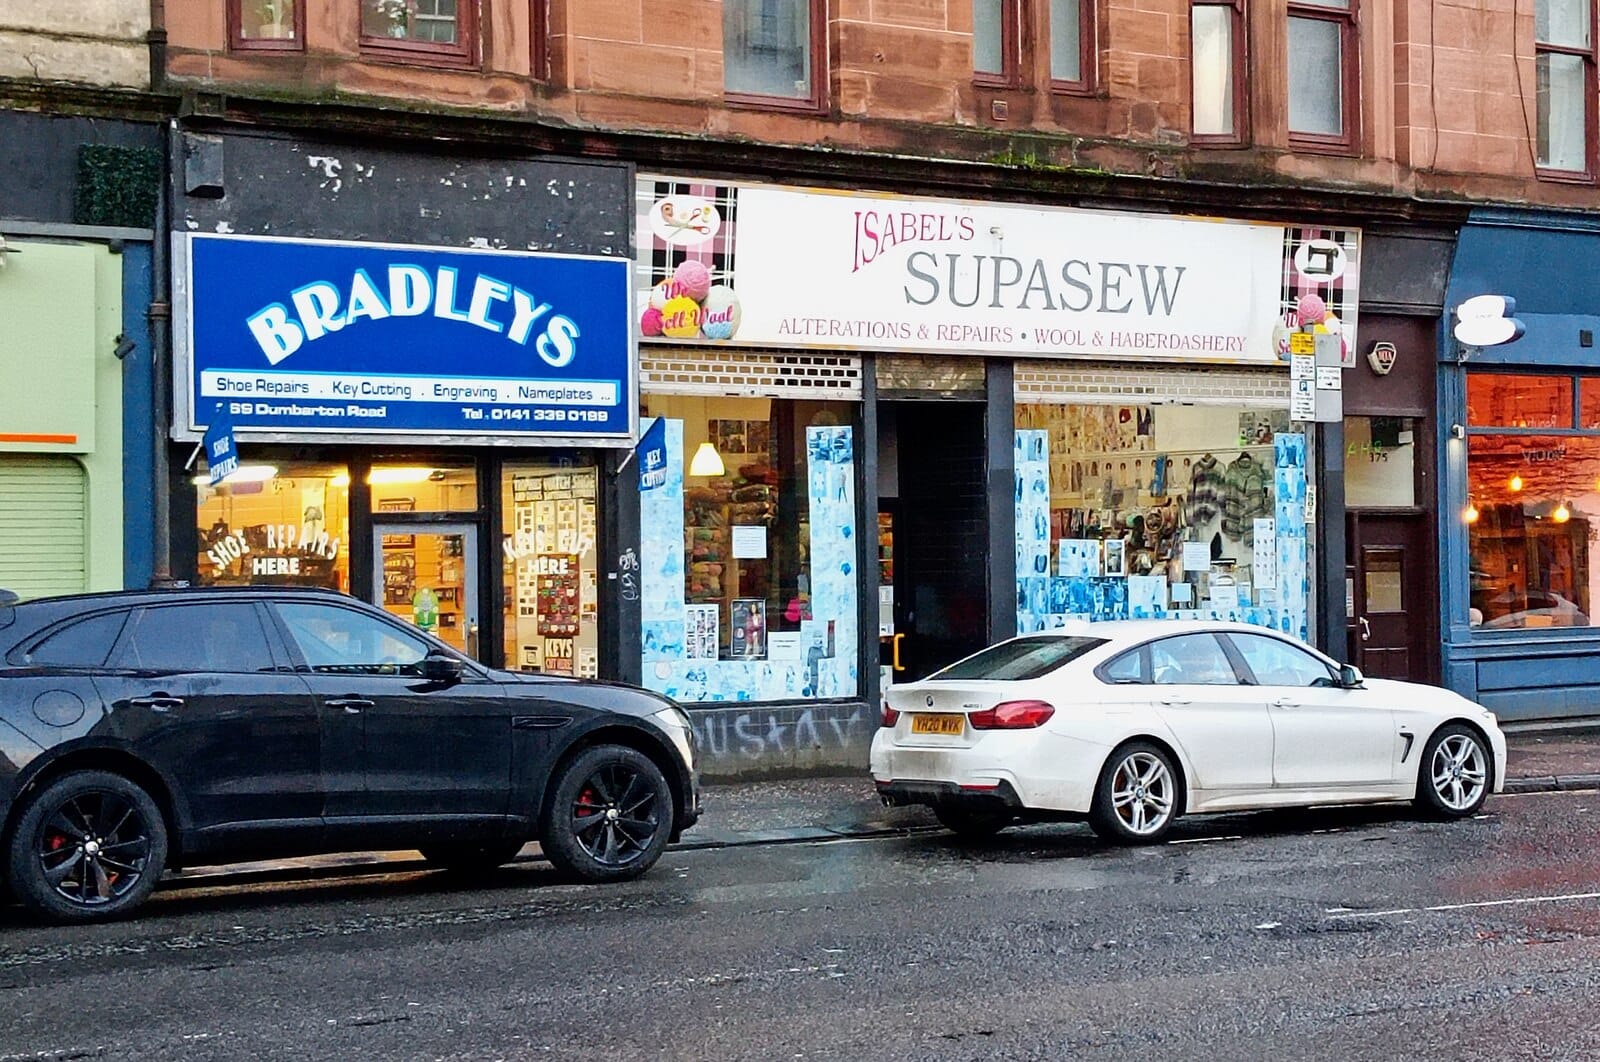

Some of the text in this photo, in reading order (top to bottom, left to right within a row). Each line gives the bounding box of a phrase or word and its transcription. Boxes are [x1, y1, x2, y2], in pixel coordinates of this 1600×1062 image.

[851, 210, 975, 274] ISABEL'S
[903, 251, 1187, 316] SUPASEW
[246, 263, 581, 368] BRADLEYS
[689, 304, 733, 326] Wool
[778, 318, 1248, 351] ALTERATIONS & REPAIRS WOOL & HABERDASHERY
[216, 377, 593, 402] Shoe Repairs Key Cutting Engraving Nameplates
[255, 404, 345, 417] Dumbarton
[347, 406, 387, 418] Road
[491, 408, 530, 421] 0141
[207, 523, 341, 571] SHOE REPAIRS
[252, 556, 300, 576] HERE
[527, 557, 569, 575] HERE
[545, 638, 573, 658] KEYS
